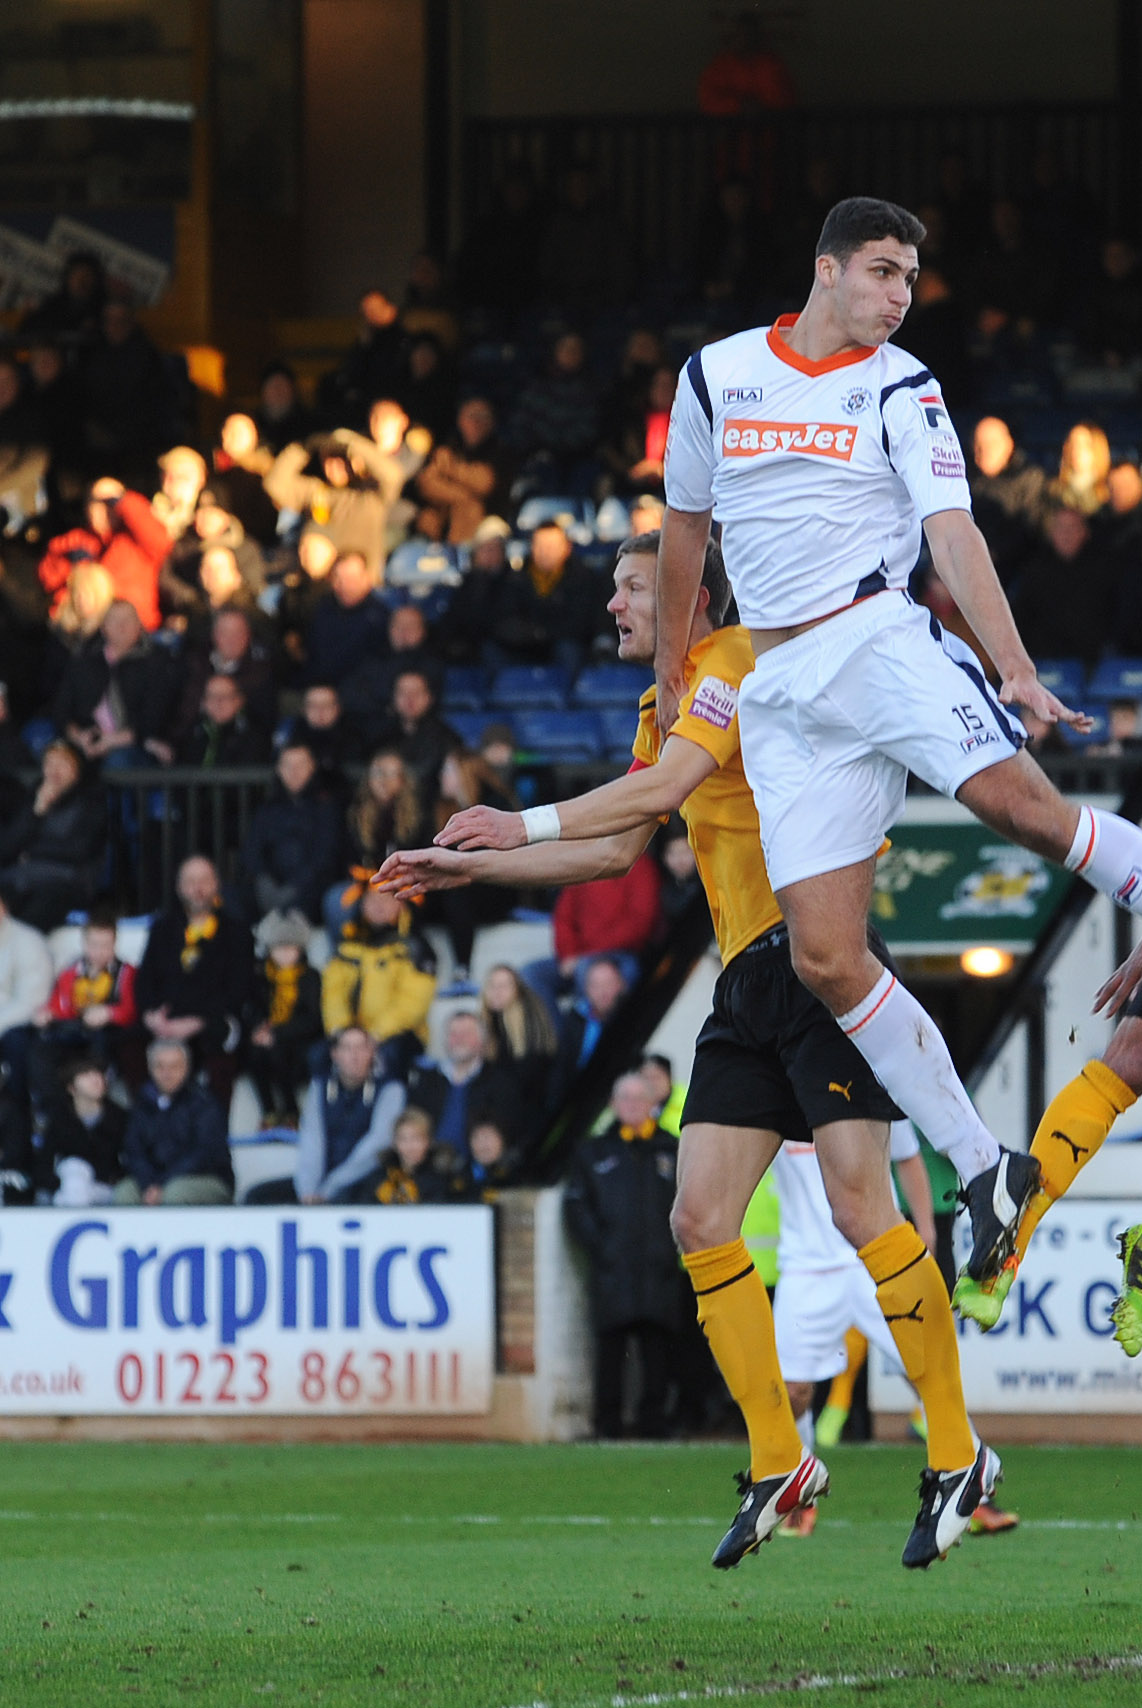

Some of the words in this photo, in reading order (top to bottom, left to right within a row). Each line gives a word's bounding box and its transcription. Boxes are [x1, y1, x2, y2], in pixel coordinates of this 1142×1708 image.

[727, 389, 758, 401] FILA
[724, 423, 853, 454] easyJet
[700, 686, 735, 713] Skrill
[692, 701, 728, 727] Premier
[951, 704, 985, 733] 15
[965, 731, 996, 752] FILA
[48, 1220, 452, 1344] Graphics
[116, 1350, 272, 1405] 01223
[299, 1350, 464, 1405] 863111
